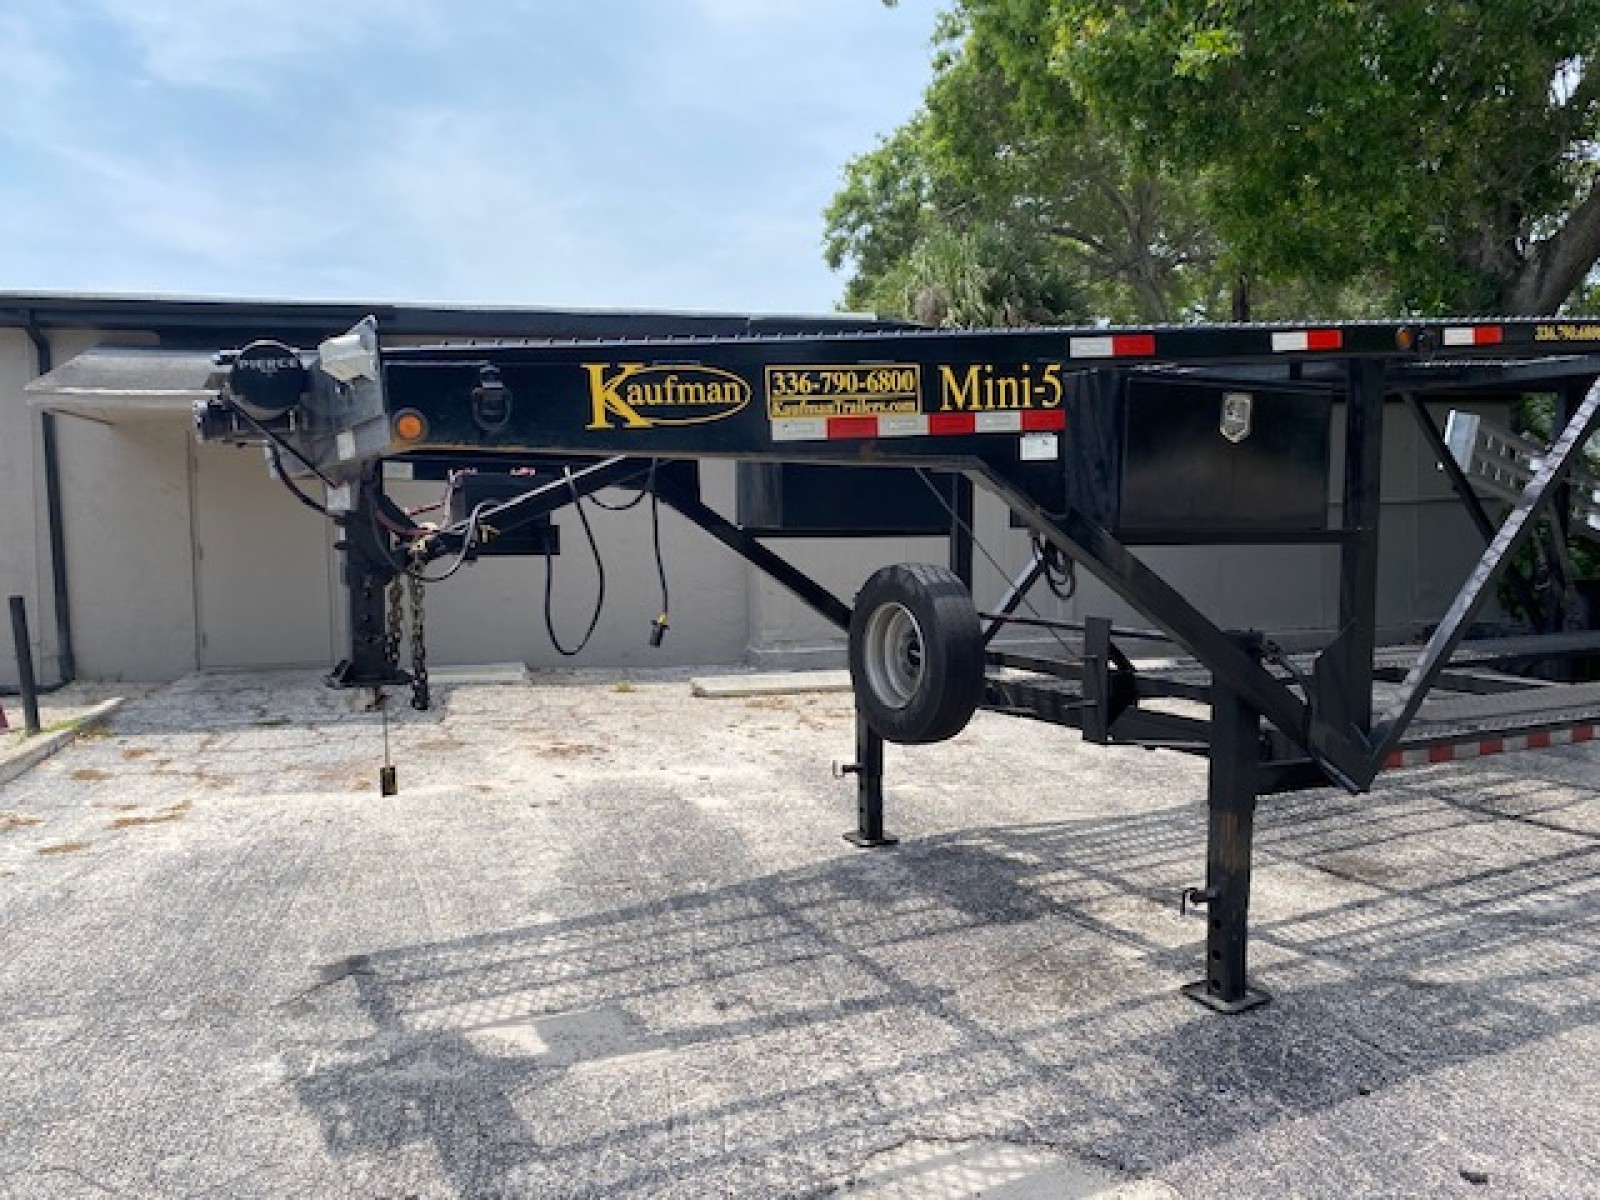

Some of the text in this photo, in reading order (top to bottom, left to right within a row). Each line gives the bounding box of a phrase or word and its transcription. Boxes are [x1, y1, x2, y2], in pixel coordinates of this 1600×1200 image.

[580, 363, 741, 430] Kaufman
[771, 370, 917, 395] 336-790-6800
[937, 363, 1063, 412] Mini-5
